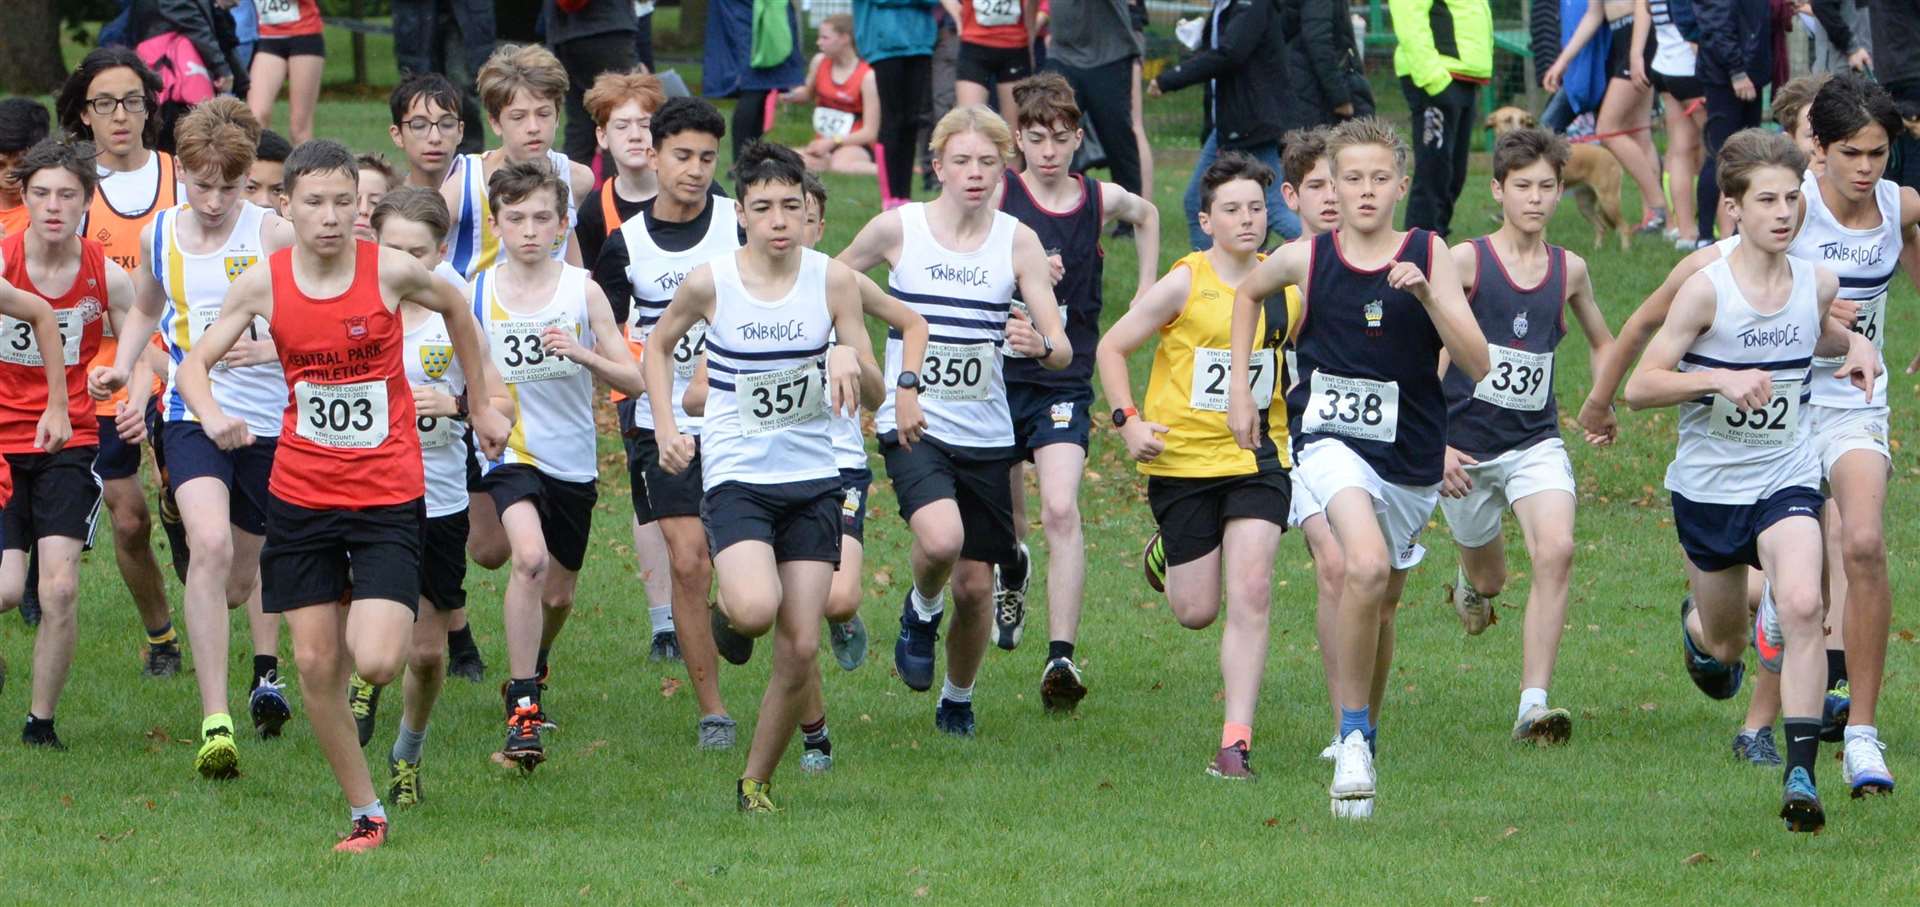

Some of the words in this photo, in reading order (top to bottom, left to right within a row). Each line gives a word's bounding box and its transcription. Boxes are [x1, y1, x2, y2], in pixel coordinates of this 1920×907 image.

[1818, 242, 1883, 266] TONBRIDGE
[925, 263, 989, 286] TONBRIDGE
[737, 319, 804, 341] TONBRIDGE
[1852, 312, 1877, 341] 56
[11, 322, 68, 350] 35
[1736, 323, 1799, 348] TONBRIDGE
[348, 341, 382, 361] PARK
[674, 331, 706, 363] 34
[1499, 349, 1512, 357] KENT
[1513, 352, 1531, 360] CROSS
[526, 366, 551, 374] COUNTY
[527, 370, 567, 380] ASSOCIATION
[747, 374, 762, 382] KENT
[763, 370, 783, 380] CROSS
[922, 355, 982, 387] 350
[754, 379, 777, 387] LEAGUE
[1205, 363, 1263, 394] 27
[1336, 378, 1355, 387] CROSS
[1356, 381, 1384, 389] COUNTRY
[1491, 361, 1543, 396] 339
[312, 390, 334, 398] LEAGUE
[321, 384, 342, 392] CROSS
[343, 384, 373, 392] COUNTRY
[1327, 383, 1348, 391] LEAGUE
[752, 375, 809, 418] 357
[1478, 392, 1503, 405] ATHLETICS
[1505, 401, 1536, 409] ASSOCIATION
[1507, 395, 1527, 404] COUNTY
[309, 396, 373, 432] 303
[1319, 388, 1382, 426] 338
[775, 412, 799, 423] COUNTY
[1337, 424, 1363, 432] COUNTY
[1337, 430, 1379, 439] ASSOCIATION
[1728, 429, 1744, 437] KENT
[1711, 430, 1741, 442] ATHLETICS
